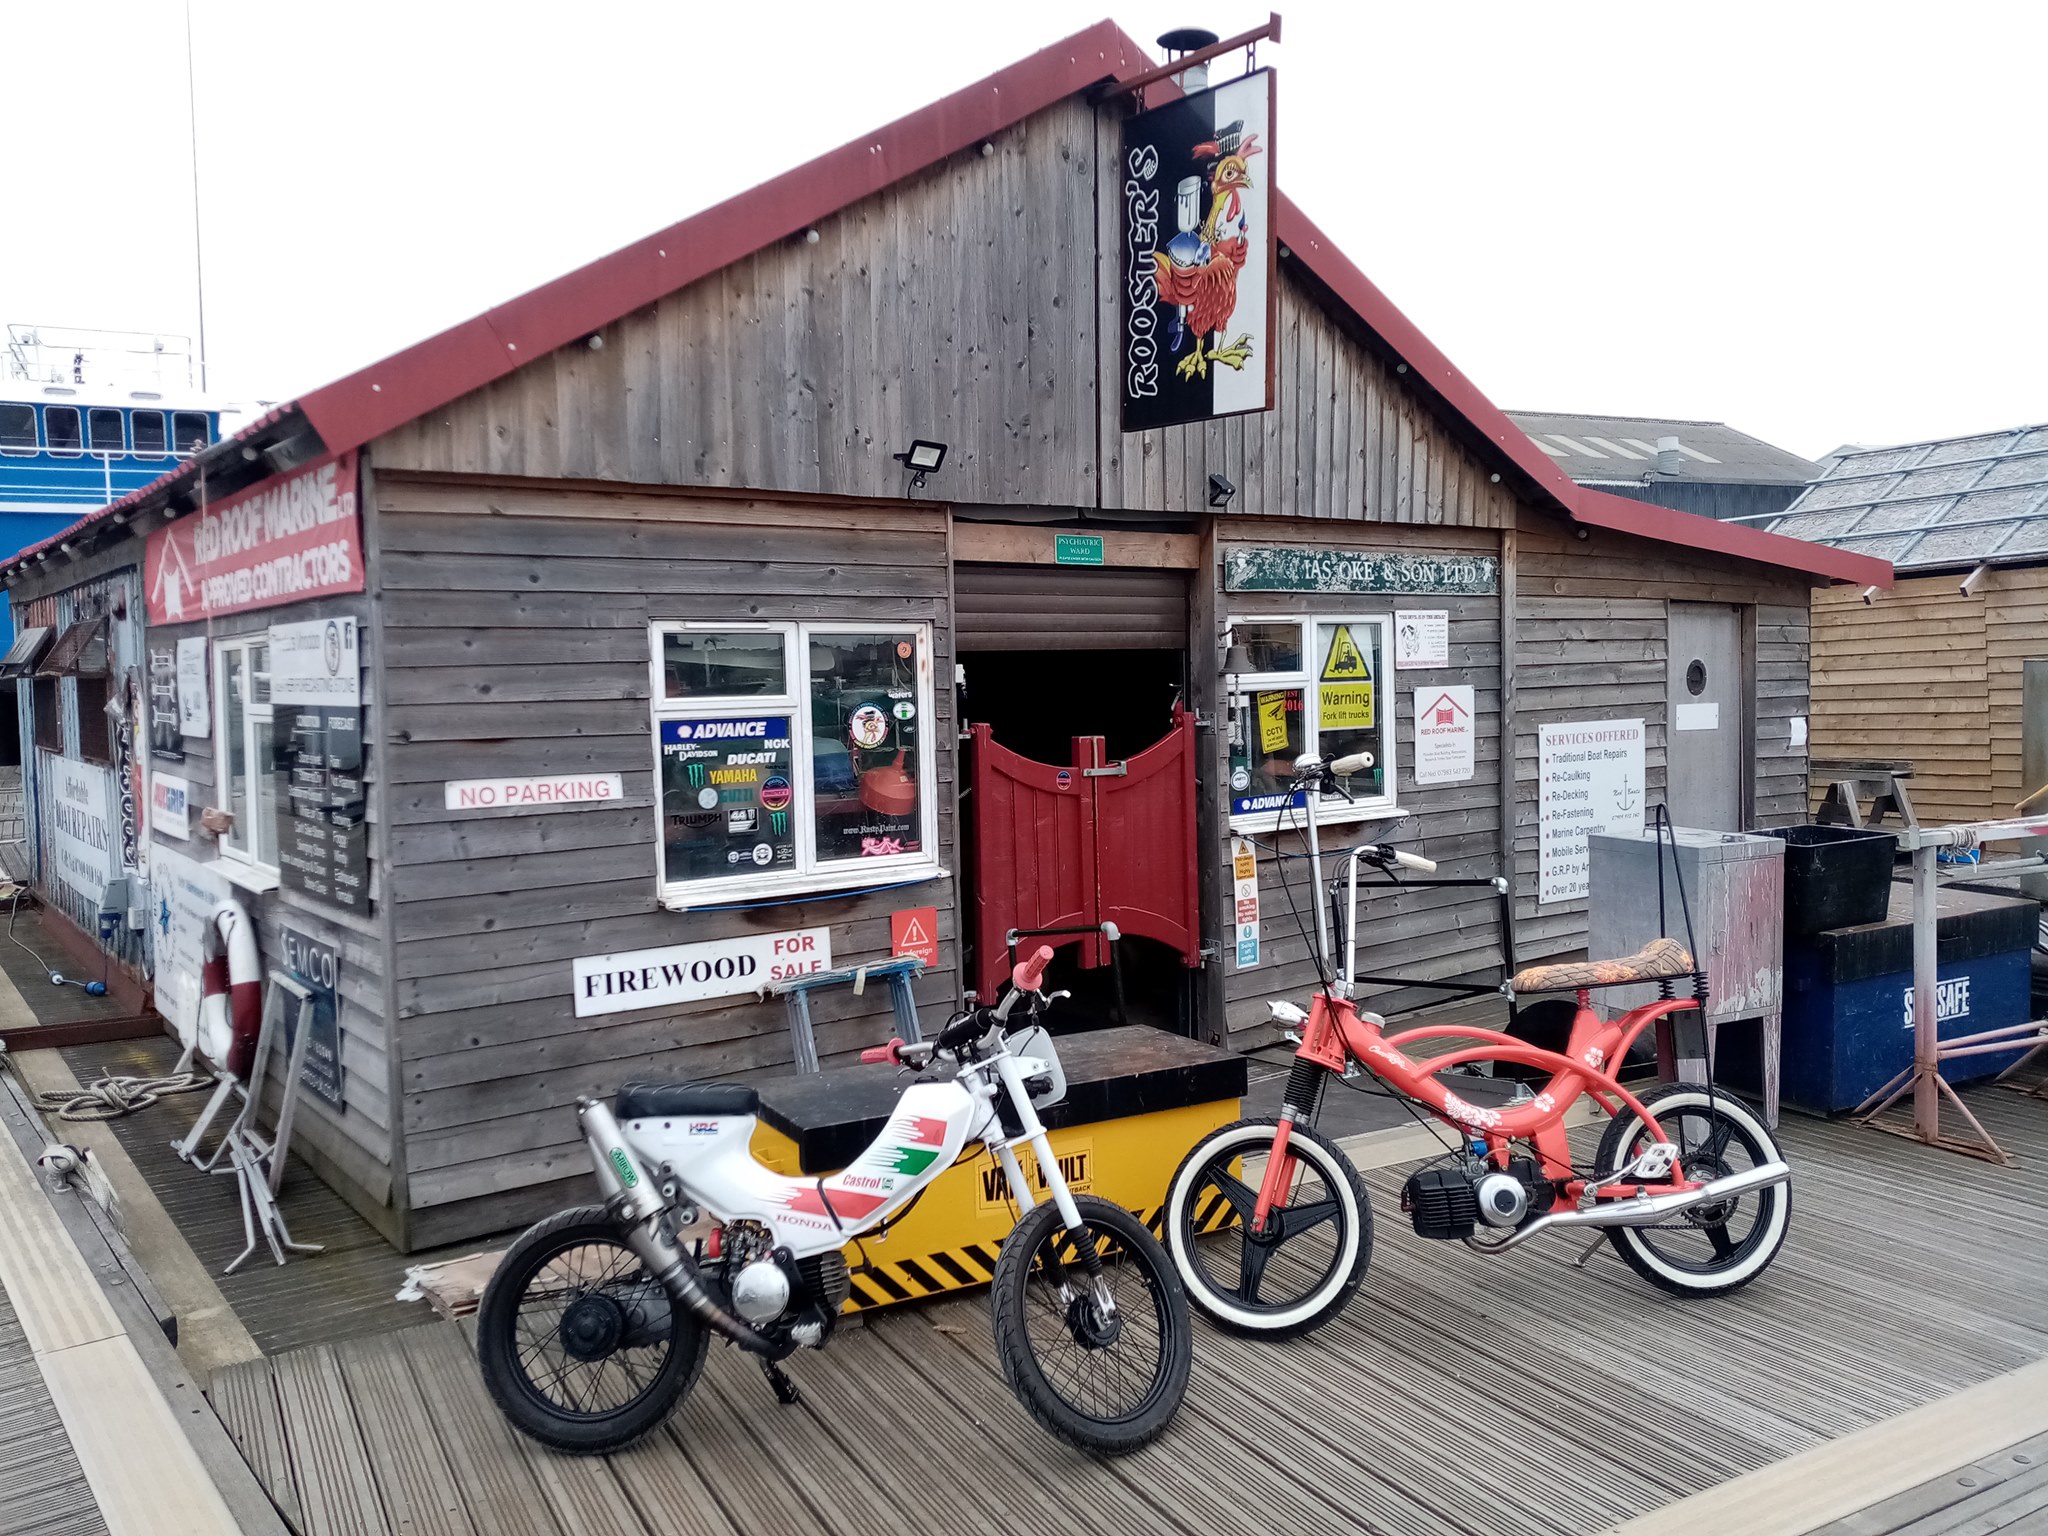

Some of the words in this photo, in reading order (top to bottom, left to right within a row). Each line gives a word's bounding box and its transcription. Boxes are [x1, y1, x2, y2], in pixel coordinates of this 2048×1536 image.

[1125, 144, 1159, 399] ROOSTER'S
[193, 515, 221, 566] RED
[221, 495, 264, 558] ROOF
[263, 462, 338, 543] MARINE
[1058, 537, 1101, 547] PSYCHIATRIC
[1070, 547, 1091, 555] WARD
[201, 568, 250, 611] APPROVED
[252, 538, 351, 600] CONTRACTORS
[1339, 558, 1376, 581] OKE
[1383, 558, 1395, 580] &
[1400, 562, 1436, 584] SON
[1260, 691, 1285, 704] WARNING
[1287, 690, 1298, 698] EST
[1321, 690, 1370, 708] Warning
[1283, 700, 1304, 711] 2016
[1322, 711, 1337, 721] Fork
[1338, 710, 1347, 720] lift
[1348, 710, 1370, 719] trucks
[692, 721, 767, 739] ADVANCE
[1266, 725, 1283, 737] CCTV
[1432, 727, 1446, 735] ROOF
[763, 739, 791, 749] NGK
[1546, 732, 1594, 747] SERVICES
[1595, 729, 1639, 743] OFFERED
[679, 750, 718, 761] DAVIDSON
[727, 752, 776, 765] DUCATI
[1552, 751, 1586, 764] Traditional
[1587, 750, 1603, 761] Boat
[1604, 748, 1627, 761] Repairs
[709, 768, 758, 784] YAMAHA
[1552, 770, 1590, 783] Re-Caulking
[459, 786, 496, 806] NO
[505, 780, 611, 803] PARKING
[1552, 789, 1589, 801] Re-Decking
[671, 813, 722, 826] TRIUMPH
[1552, 807, 1594, 821] Re-Fastening
[71, 809, 108, 853] REPAIRS
[1552, 827, 1573, 839] Marine
[1552, 846, 1573, 858] Mobile
[1575, 844, 1590, 855] Serv
[1572, 864, 1580, 876] by
[1581, 862, 1590, 871] Ar
[1552, 884, 1567, 896] Over
[1569, 882, 1577, 893] 20
[1578, 882, 1590, 894] yea
[774, 936, 815, 956] FOR
[280, 933, 333, 989] SEMCO
[583, 954, 757, 999] FIREWOOD
[688, 1121, 719, 1132] HRC
[614, 1151, 636, 1182] ARROW
[1036, 1154, 1087, 1189] VULT
[842, 1174, 881, 1189] Castrol
[776, 1212, 833, 1232] HONDA
